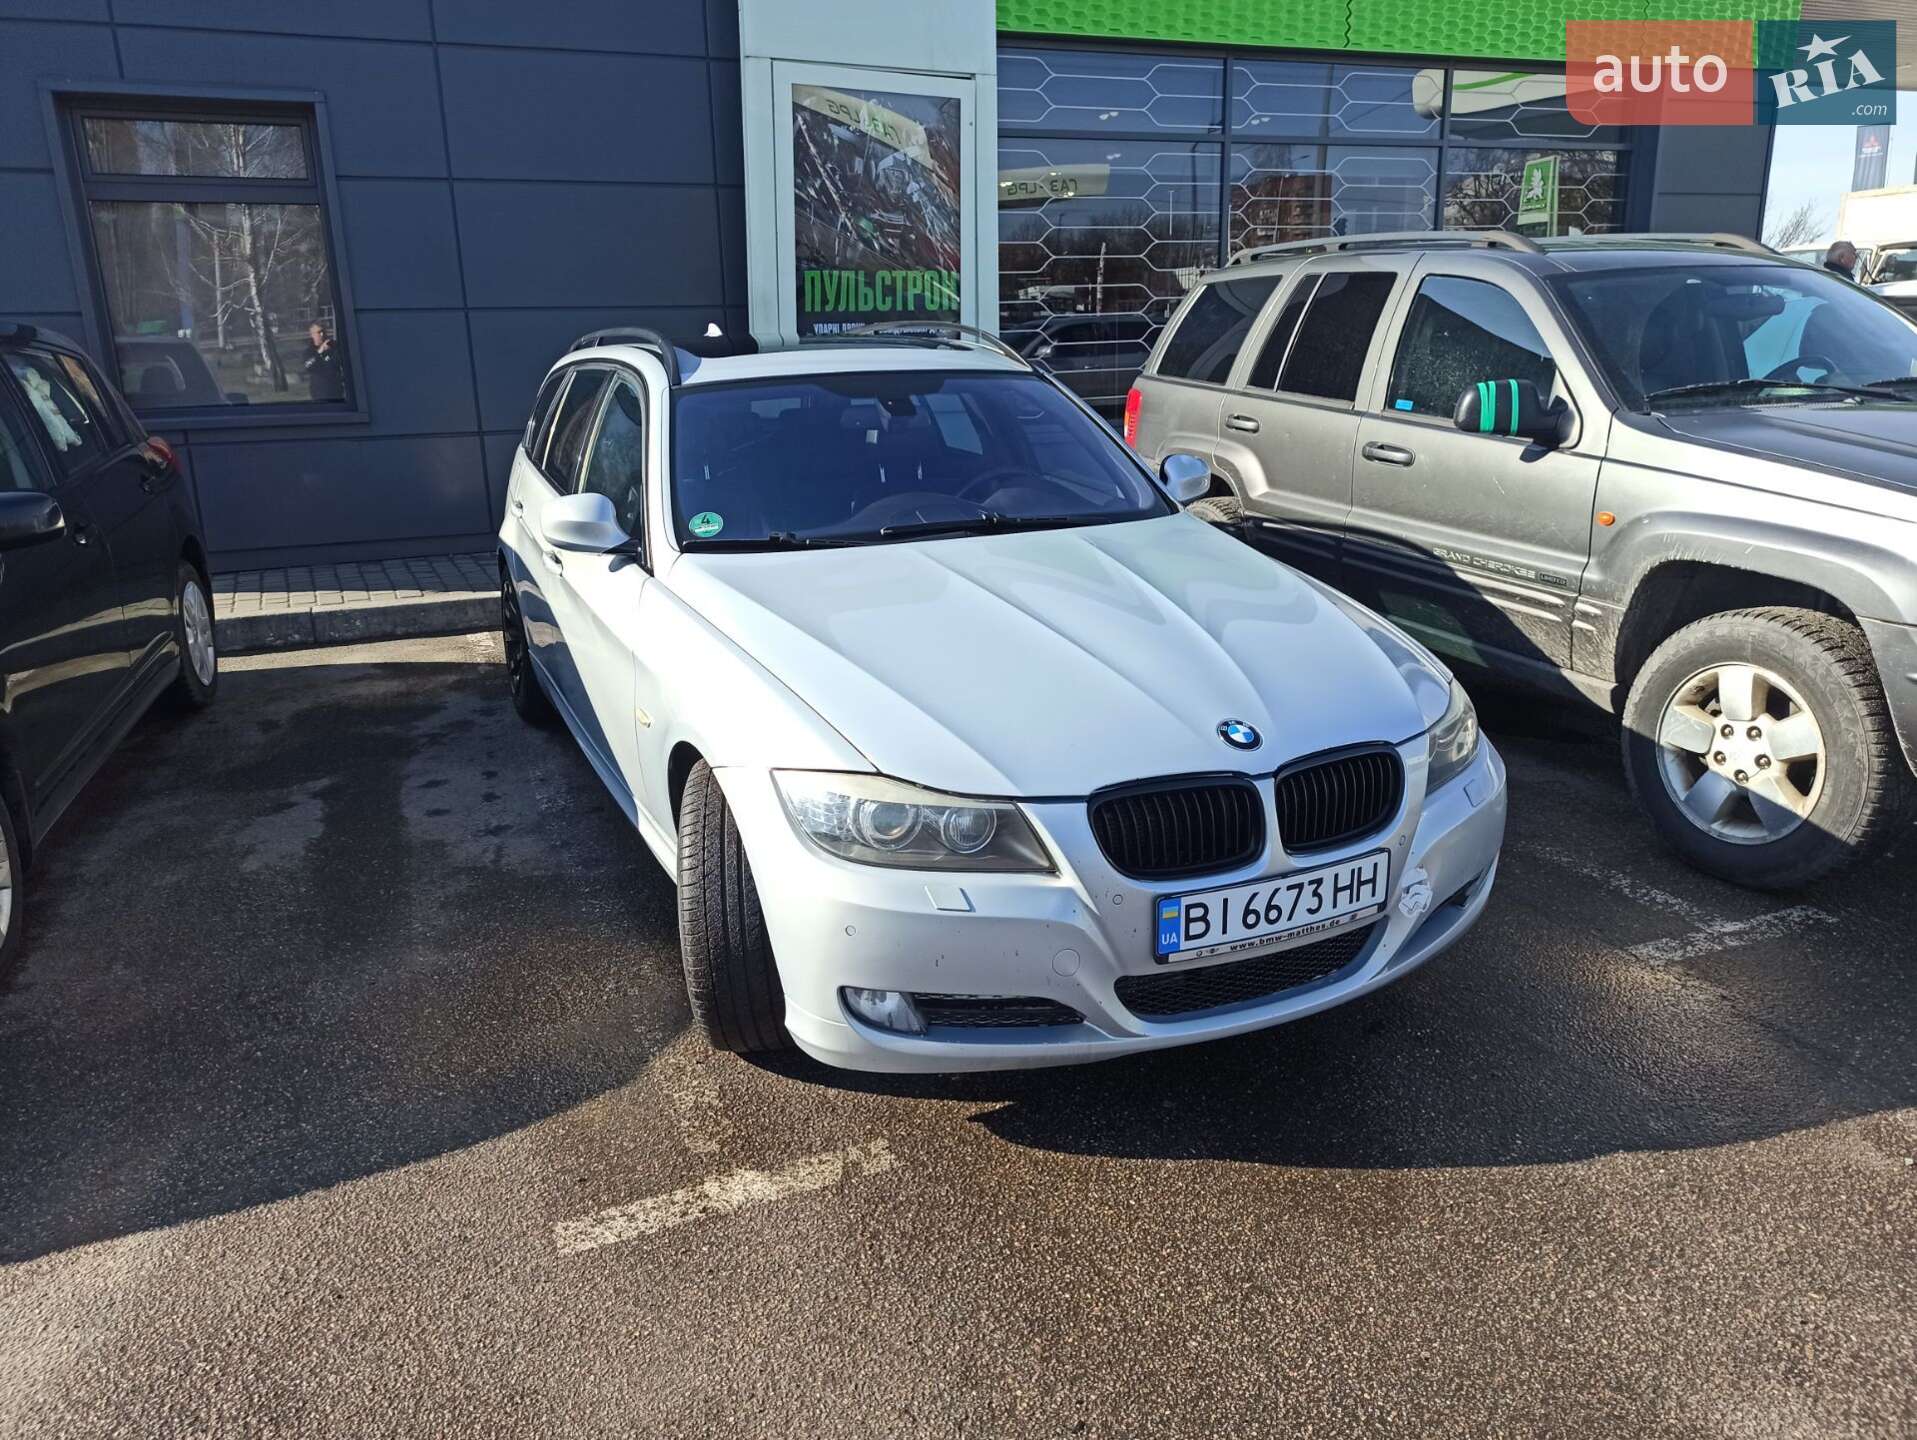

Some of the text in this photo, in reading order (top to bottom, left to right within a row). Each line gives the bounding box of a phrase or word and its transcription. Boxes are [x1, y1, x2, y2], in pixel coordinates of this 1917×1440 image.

[804, 269, 960, 313] ПУЛЬСТРОН
[1433, 547, 1471, 563] GRAND
[1473, 557, 1536, 579] CHEROKEE
[1184, 861, 1379, 942] BI 6673 HH
[1161, 932, 1178, 945] UA
[1230, 918, 1341, 952] www.bmw-matthes.de
